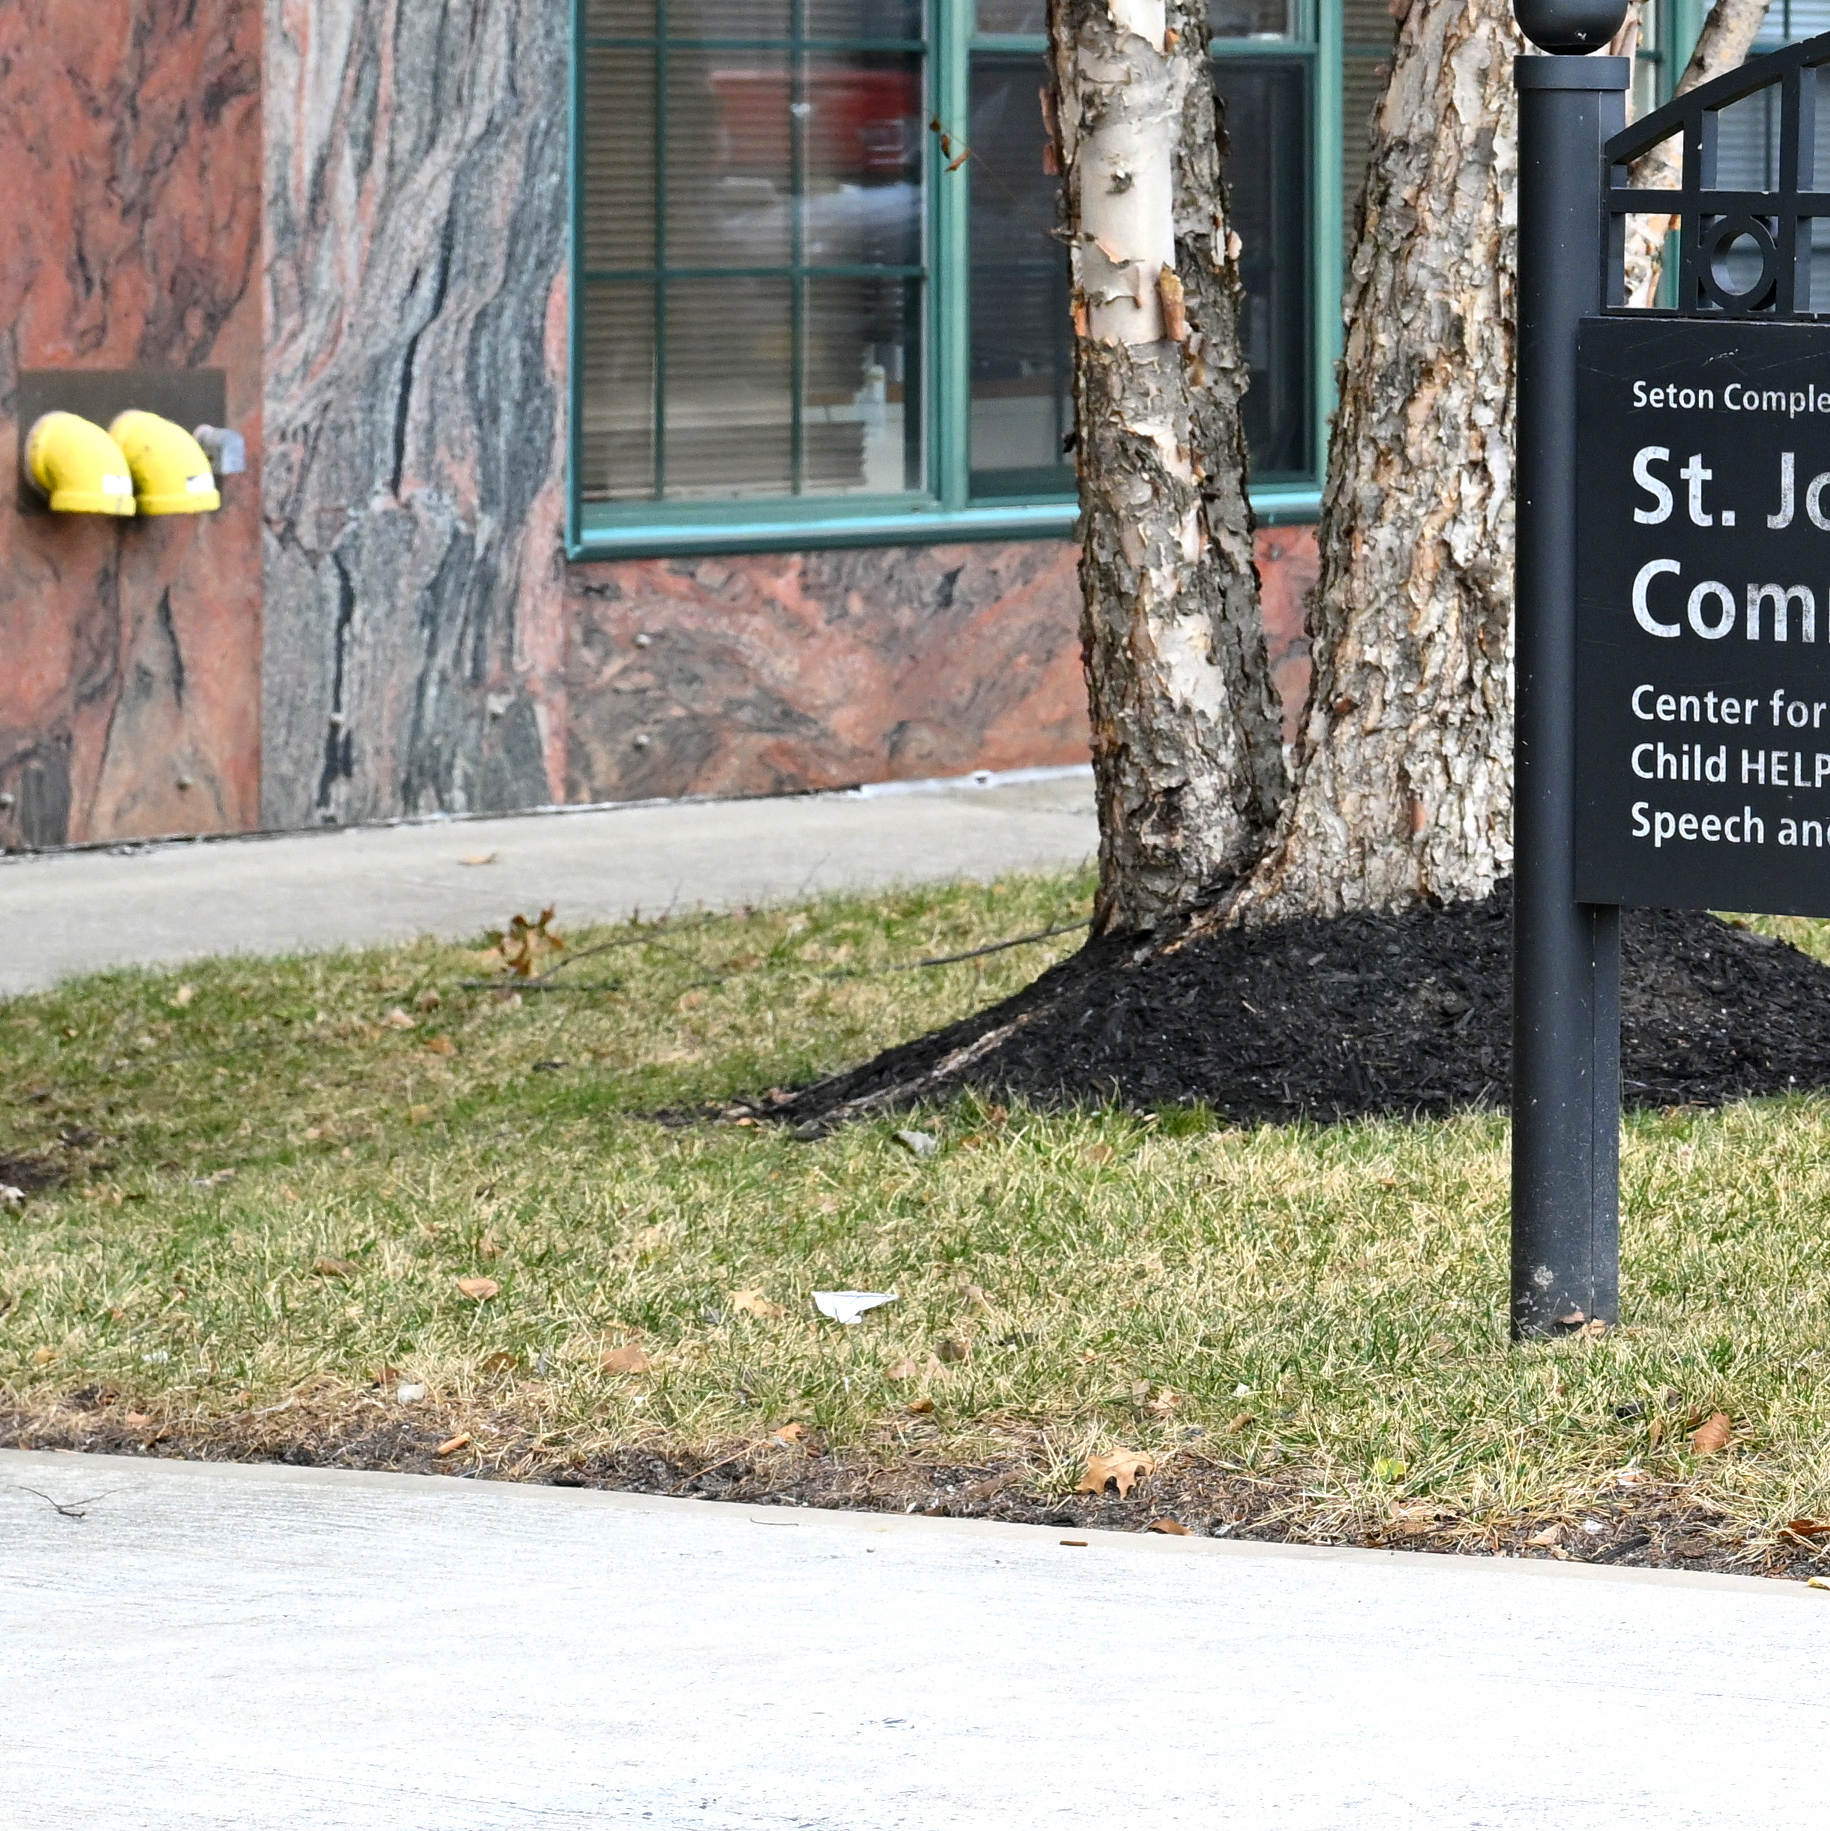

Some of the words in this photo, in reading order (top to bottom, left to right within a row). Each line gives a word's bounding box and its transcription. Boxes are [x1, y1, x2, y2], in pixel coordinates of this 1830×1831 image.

[1632, 380, 1714, 410] Seton
[1632, 445, 1736, 527] St.
[1631, 683, 1759, 725] Center
[1769, 688, 1827, 729] for
[1631, 741, 1727, 783] Child
[1631, 801, 1765, 848] Speech
